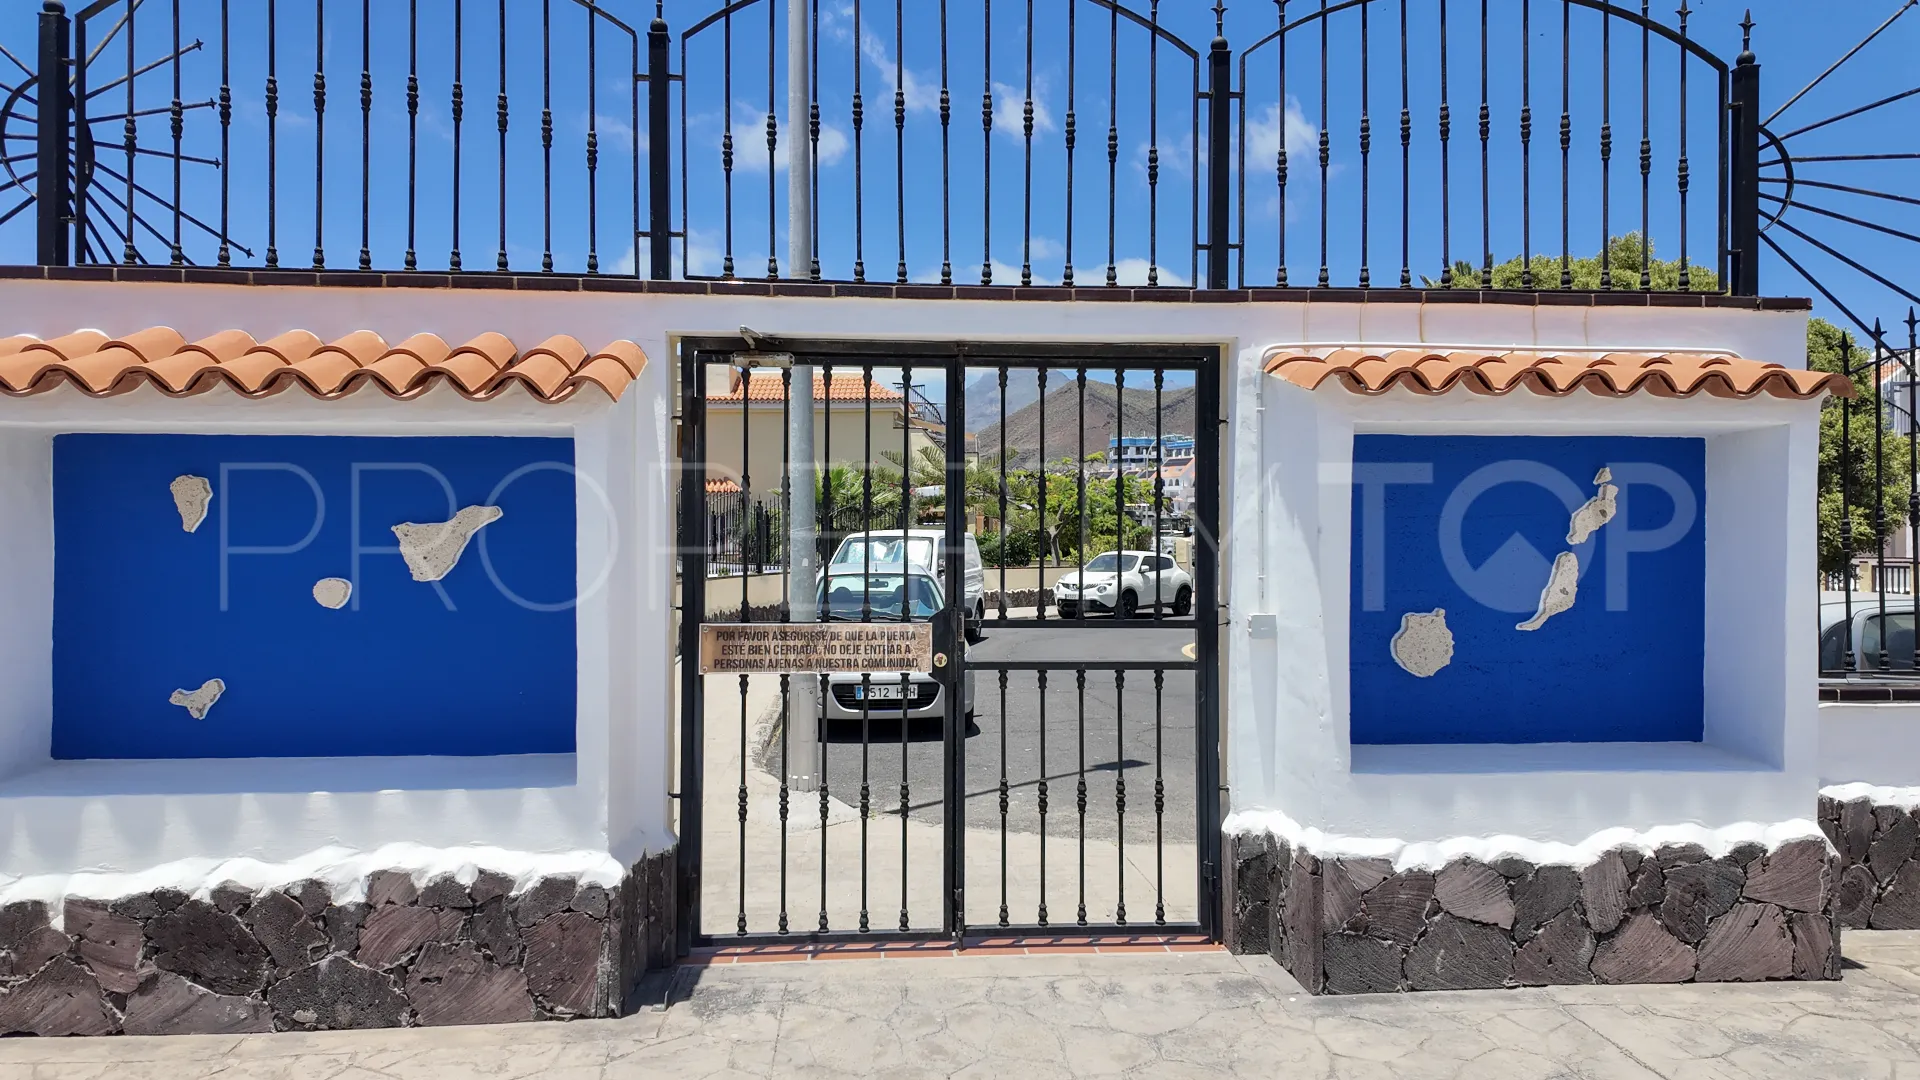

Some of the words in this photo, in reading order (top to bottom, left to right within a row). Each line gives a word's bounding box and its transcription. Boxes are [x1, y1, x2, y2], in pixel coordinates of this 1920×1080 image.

[716, 630, 736, 641] POR
[738, 630, 769, 641] FAVOR
[830, 630, 842, 641] DE
[844, 630, 864, 641] QUE
[865, 630, 878, 641] LA
[880, 630, 917, 641] PUERTA
[748, 644, 771, 655] BIEN
[824, 644, 837, 655] NO
[839, 644, 862, 655] DEJE
[864, 644, 902, 655] ENTRAR
[904, 644, 912, 655] A
[714, 658, 766, 669] PERSONAS
[768, 658, 804, 669] AJENAS
[806, 658, 813, 669] A
[814, 658, 859, 669] NUESTRA
[865, 687, 890, 698] 512
[896, 687, 916, 698] HH
